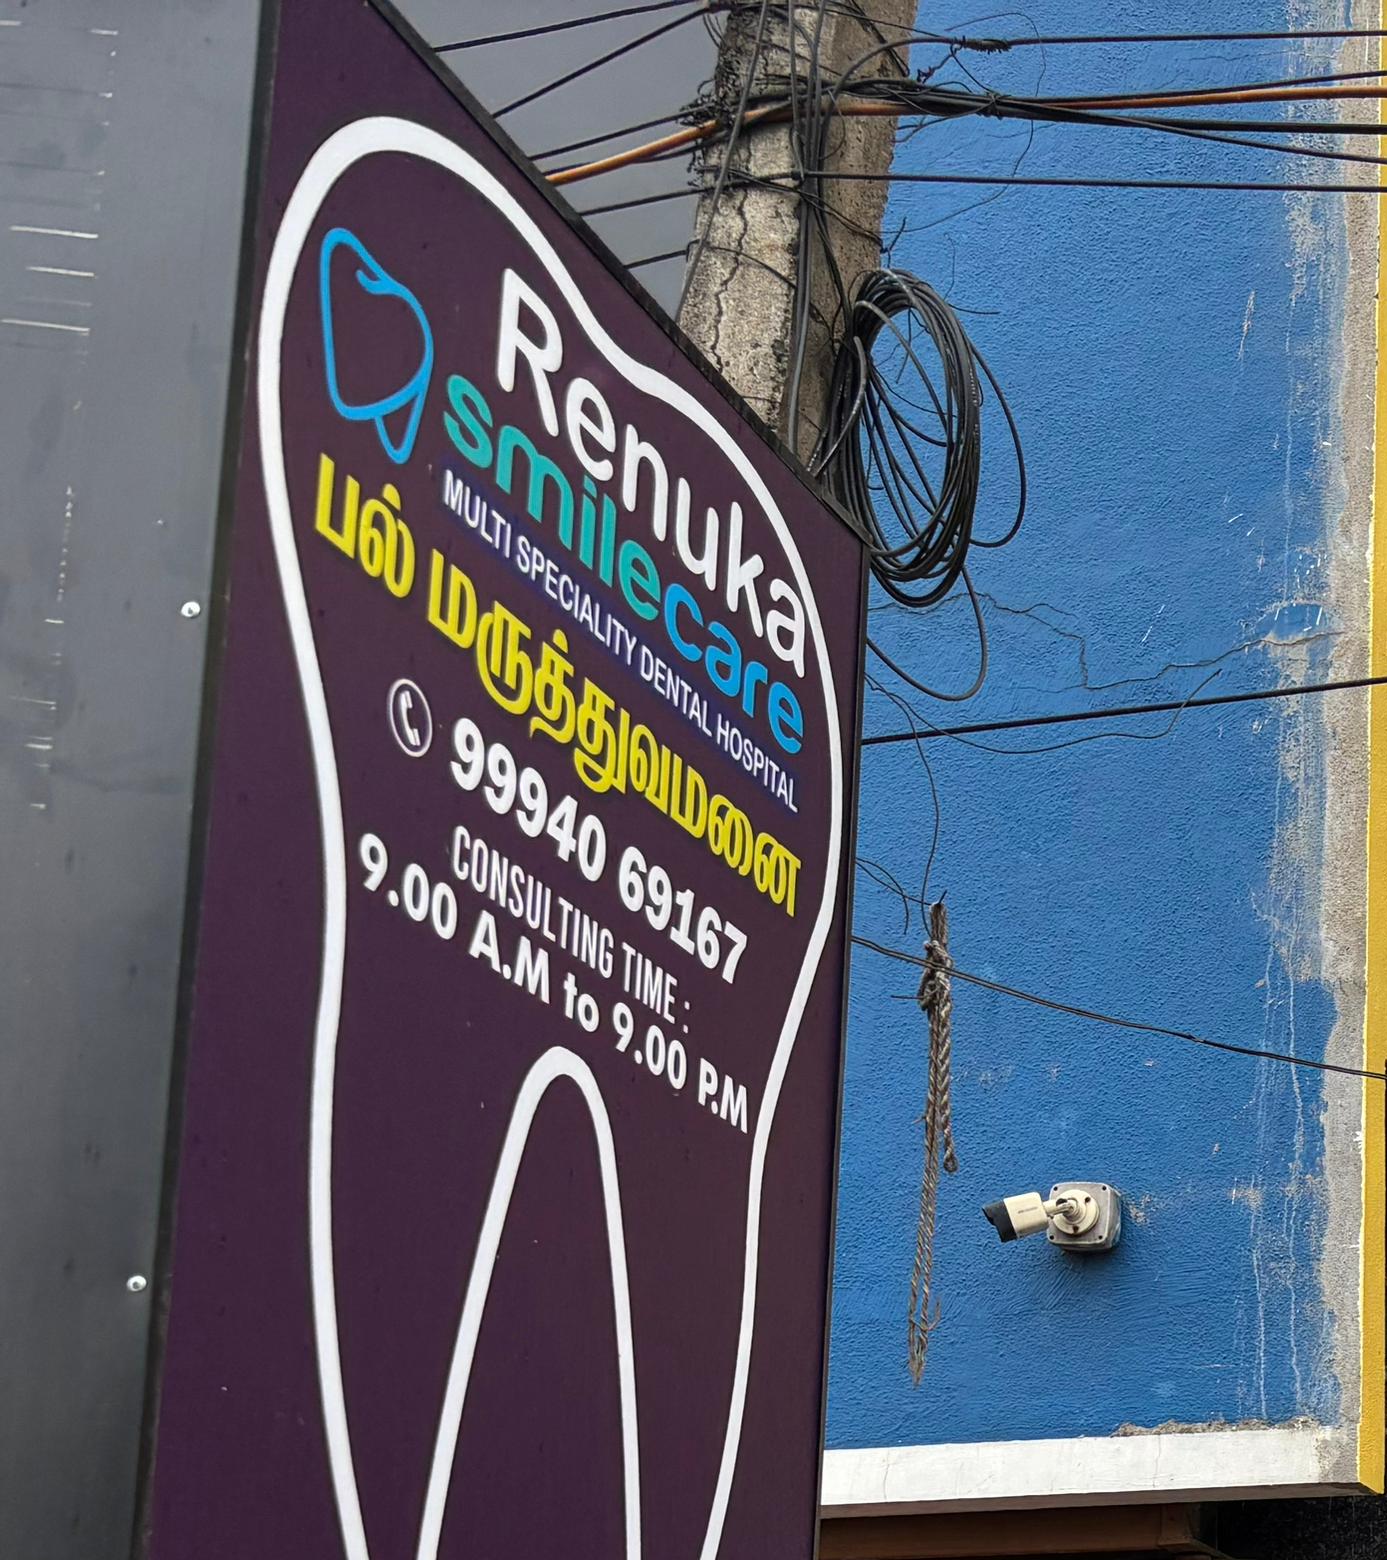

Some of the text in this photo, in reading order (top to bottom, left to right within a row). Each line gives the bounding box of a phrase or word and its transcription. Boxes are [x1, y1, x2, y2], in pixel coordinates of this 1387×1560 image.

[443, 469, 798, 813] MULTI SPECIALITY DENTAL HOSPITAL
[444, 373, 803, 753] smilecare
[497, 268, 805, 678] Renuka
[315, 453, 802, 917] பல் மருத்துவமனை
[450, 718, 748, 984] 99940 69167
[358, 833, 749, 1134] 9.00 A.M to 9.00 P.M
[451, 825, 615, 980] CONSULTING
